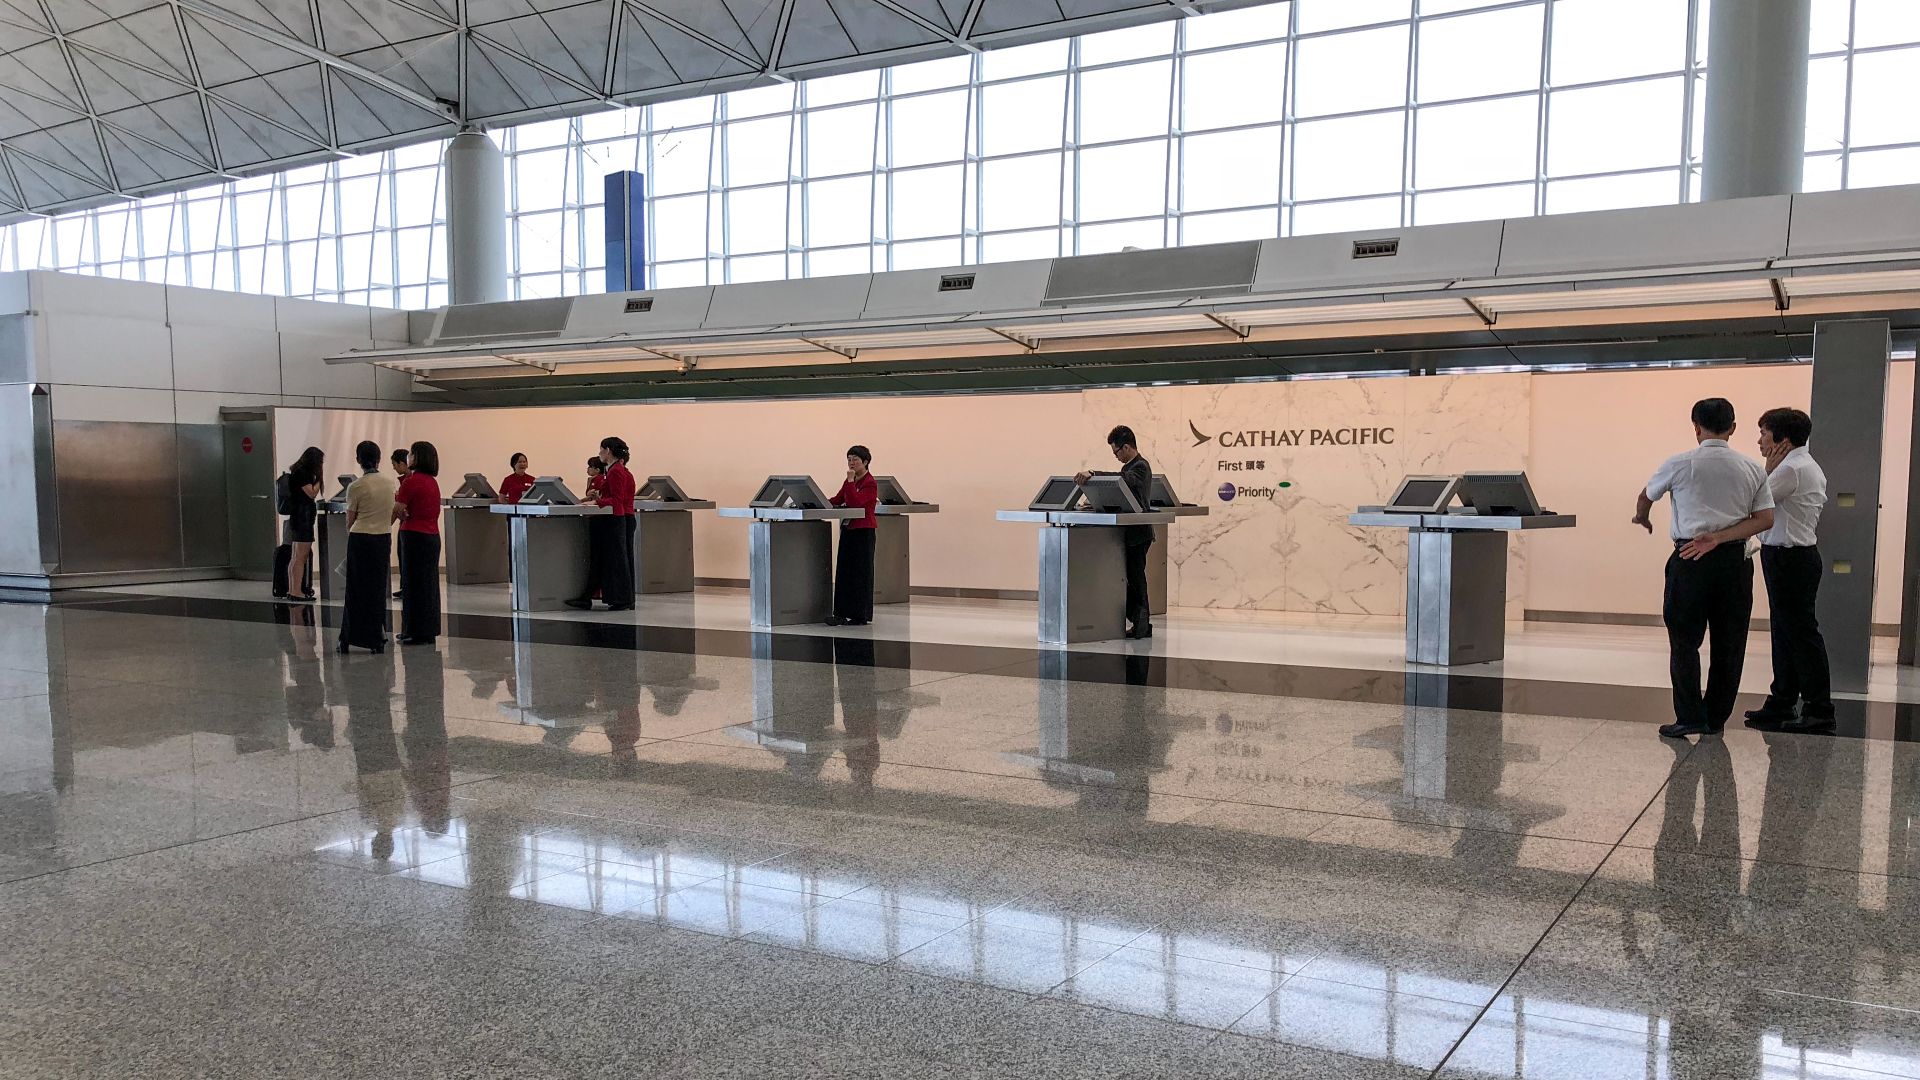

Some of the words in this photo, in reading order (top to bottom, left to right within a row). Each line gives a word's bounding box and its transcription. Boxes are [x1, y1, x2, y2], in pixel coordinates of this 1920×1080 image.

[1218, 429, 1304, 447] CATHAY
[1309, 427, 1394, 445] PACIFIC
[1218, 460, 1243, 471] First
[1245, 460, 1265, 471] 頭等
[1238, 486, 1276, 500] Priority
